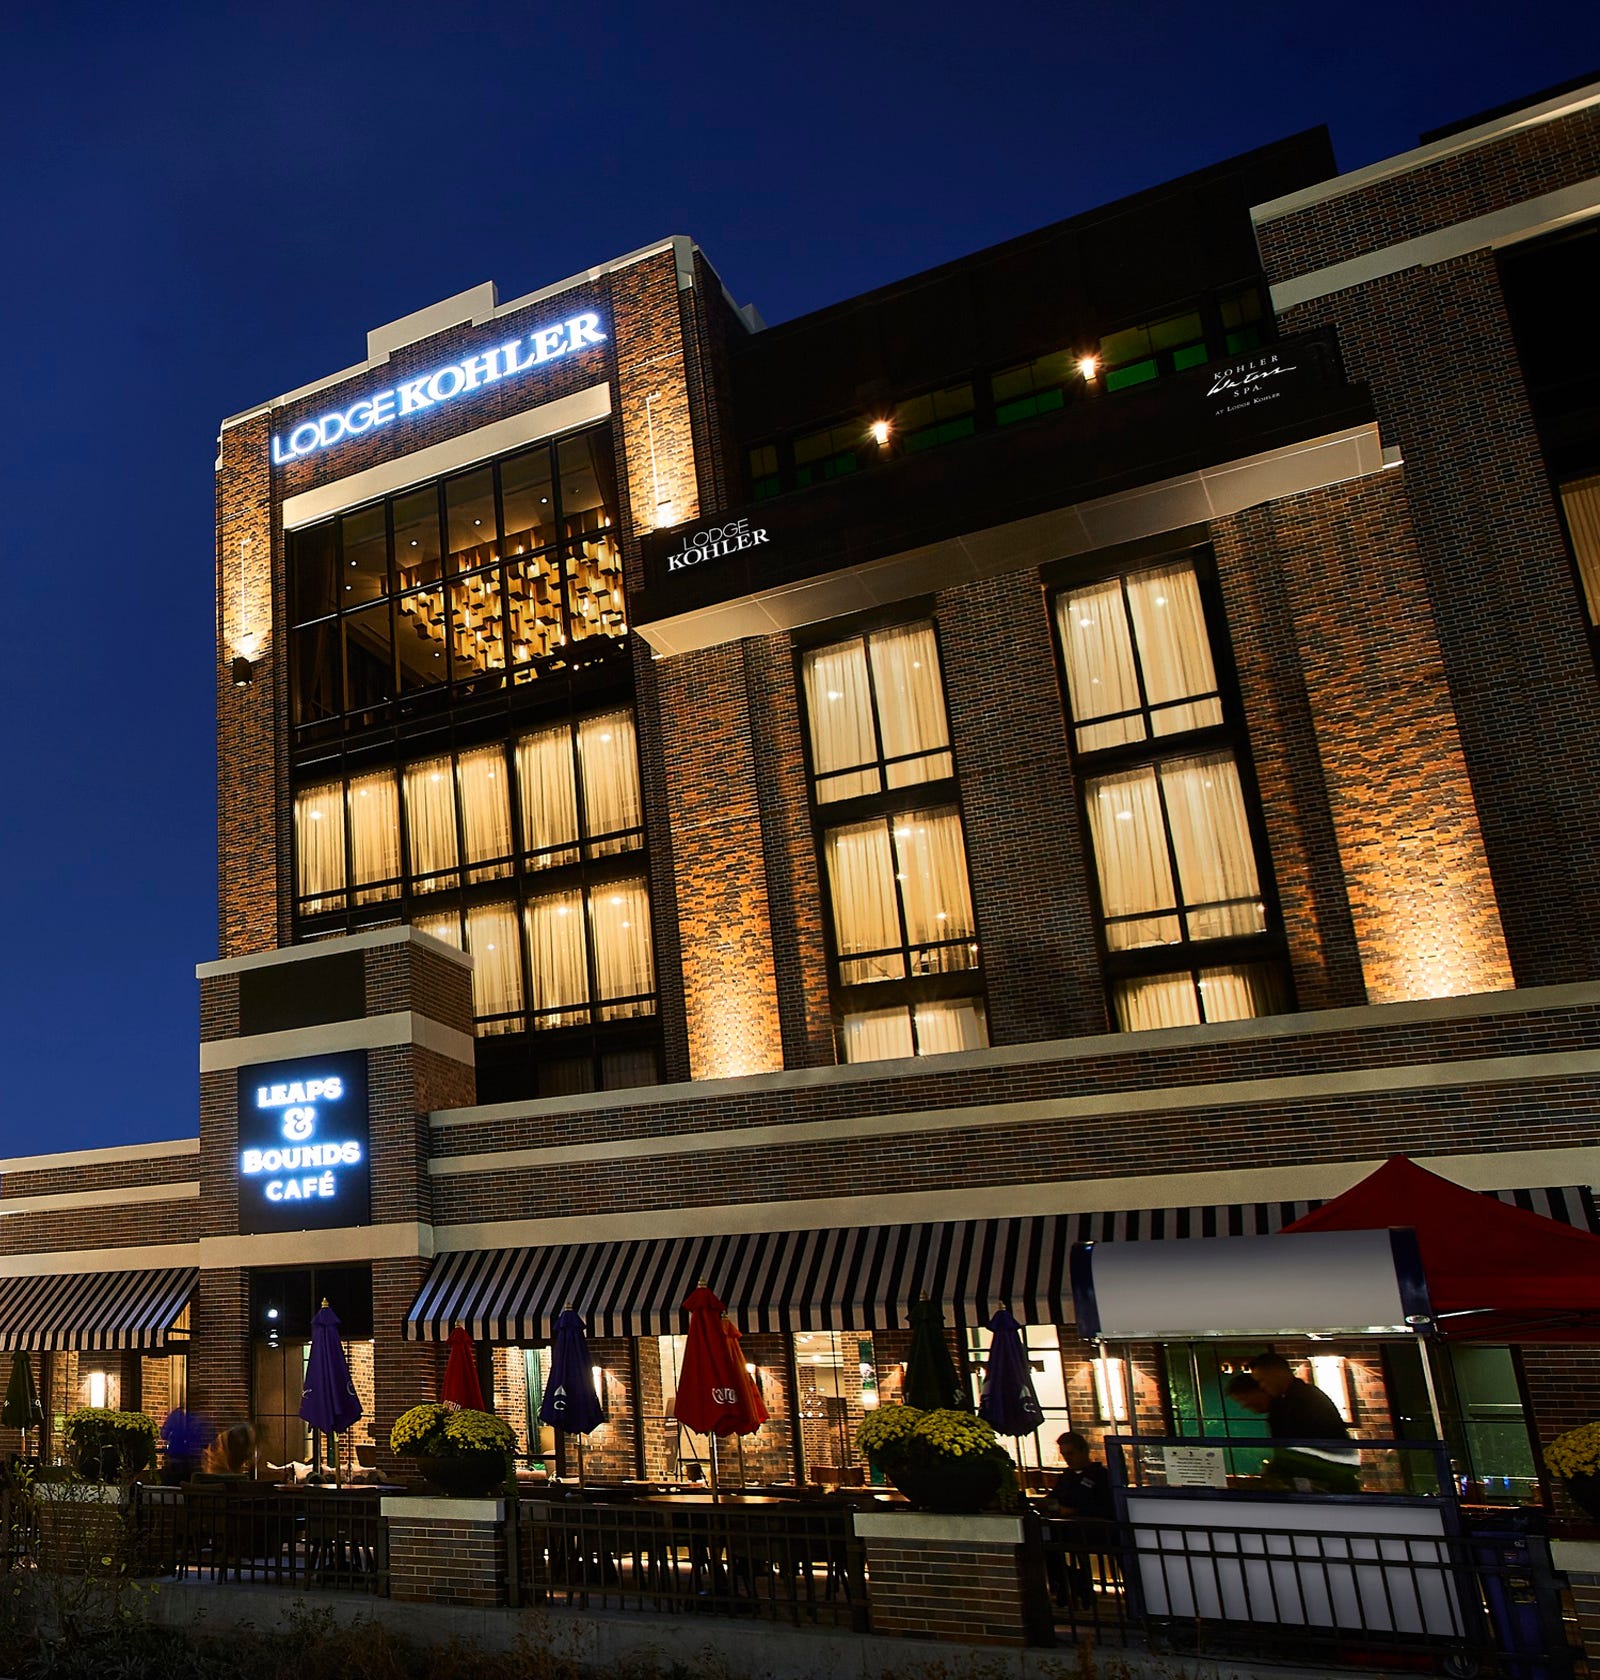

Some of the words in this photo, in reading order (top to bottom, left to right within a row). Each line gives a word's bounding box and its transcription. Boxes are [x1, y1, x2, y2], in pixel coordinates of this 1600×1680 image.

[1206, 366, 1297, 397] Waters
[1214, 355, 1278, 380] KOHLER
[273, 390, 396, 465] LODGE
[396, 312, 608, 417] KOHLER
[1234, 384, 1260, 397] SPA
[667, 528, 771, 572] KOHLER
[683, 518, 750, 551] LODGE
[257, 1077, 342, 1108] LEAPS
[283, 1106, 315, 1140] &
[242, 1141, 360, 1174] BOUNDS
[266, 1170, 335, 1201] CAFÉ
